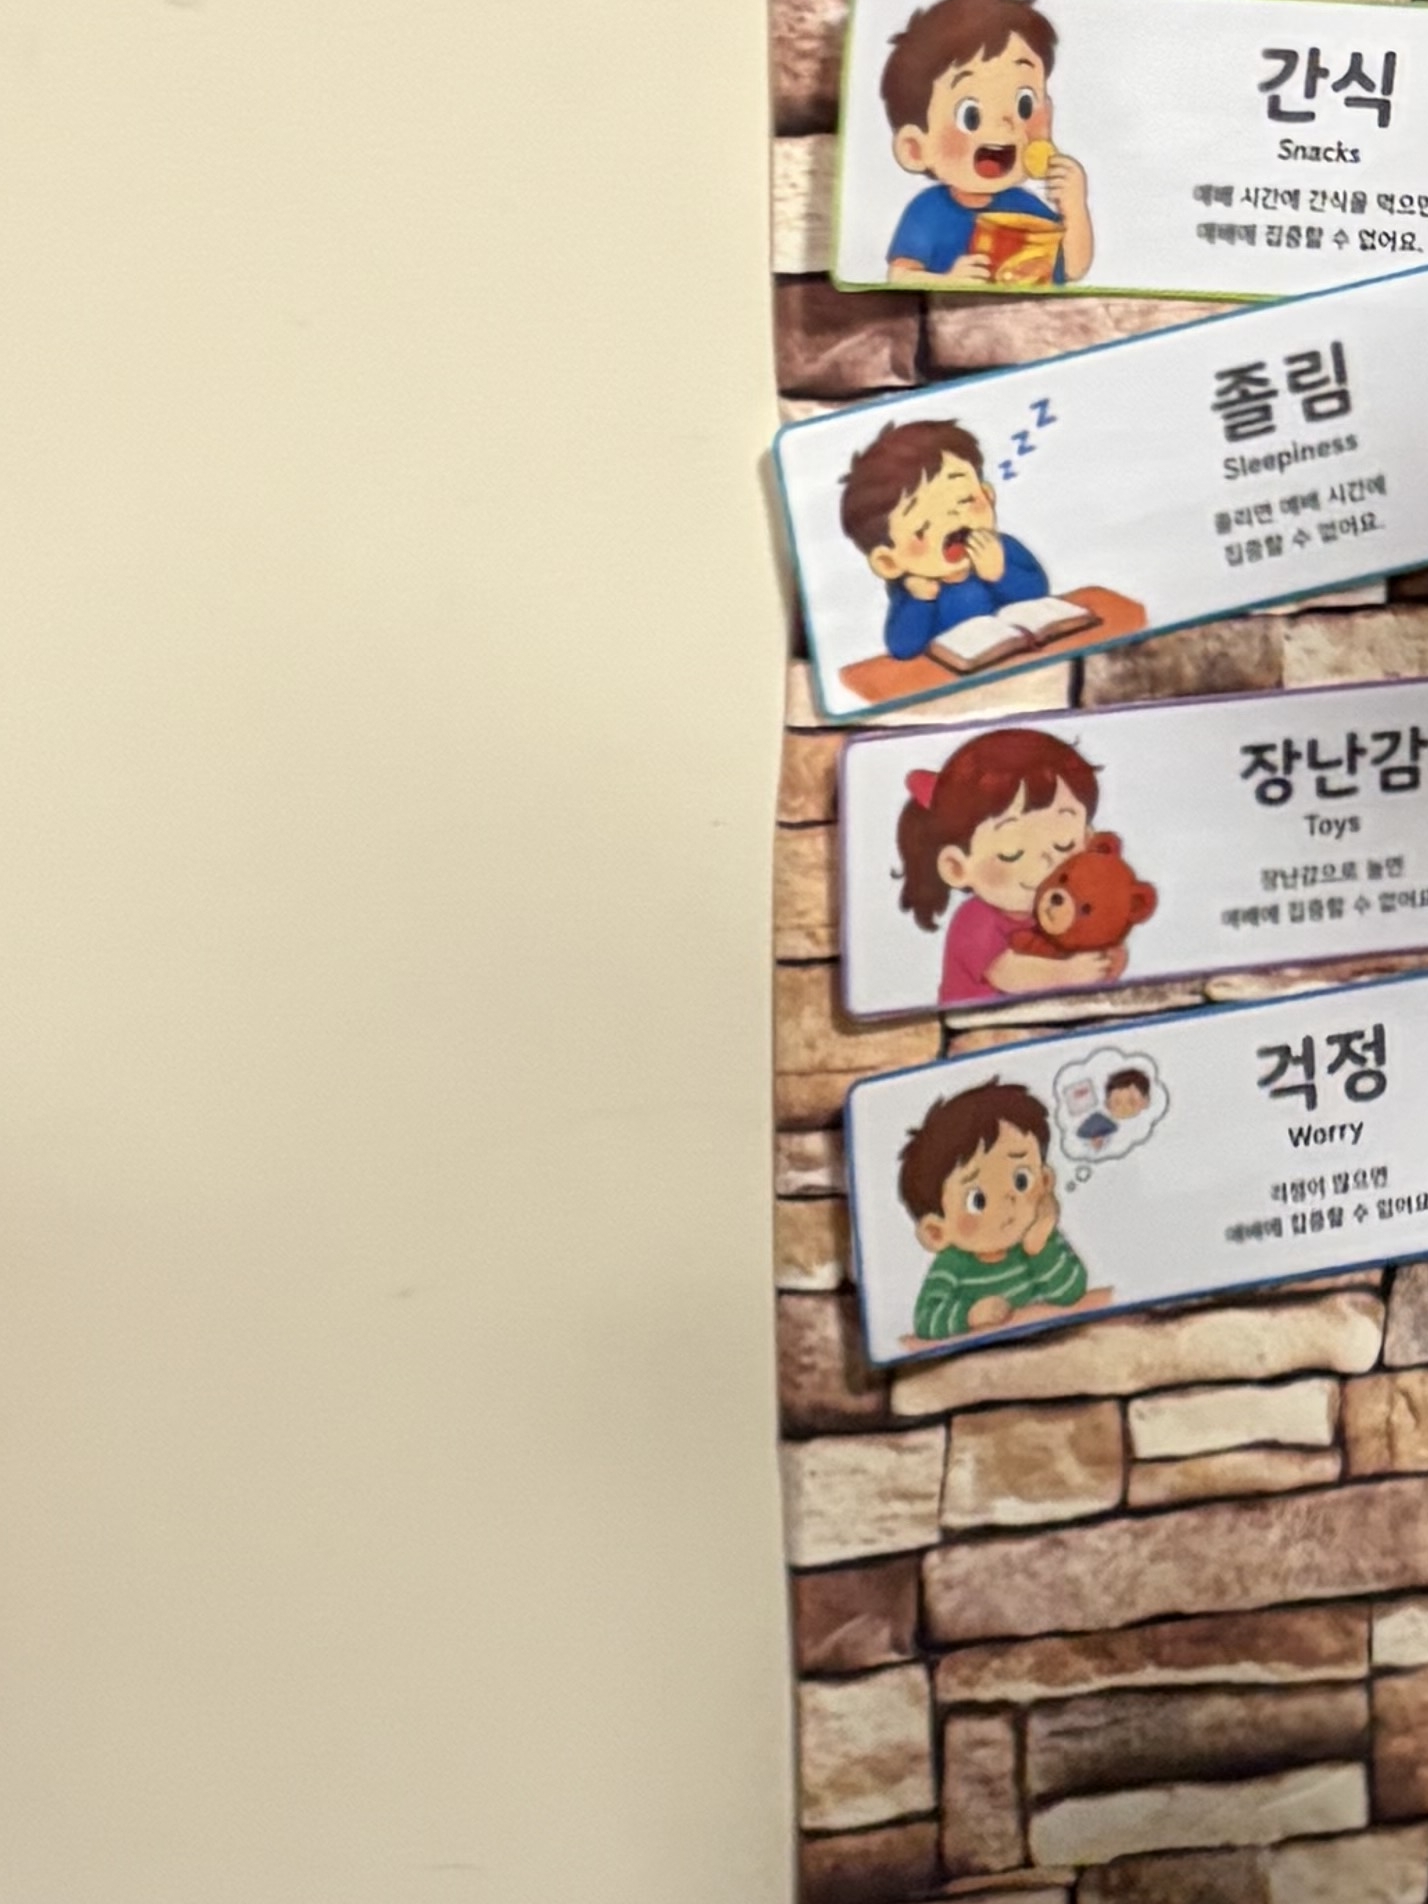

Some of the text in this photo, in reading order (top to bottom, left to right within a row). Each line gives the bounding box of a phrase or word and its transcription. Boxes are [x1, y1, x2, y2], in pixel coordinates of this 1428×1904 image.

[1257, 47, 1396, 128] 간식
[1278, 139, 1361, 163] Snacks
[1240, 187, 1300, 211] 시간에
[1310, 190, 1367, 214] 간식을
[1333, 228, 1350, 249] 수
[1359, 229, 1424, 252] 없어요.
[1211, 341, 1351, 443] 졸림
[1223, 434, 1358, 480] Sleepiness
[1329, 474, 1387, 505] 시간에
[1293, 528, 1312, 548] 수
[1304, 814, 1361, 839] Toys
[1354, 895, 1370, 916] 수
[1257, 1023, 1387, 1111] 걱정
[1288, 1122, 1363, 1147] Worry
[1354, 1203, 1368, 1223] 수
